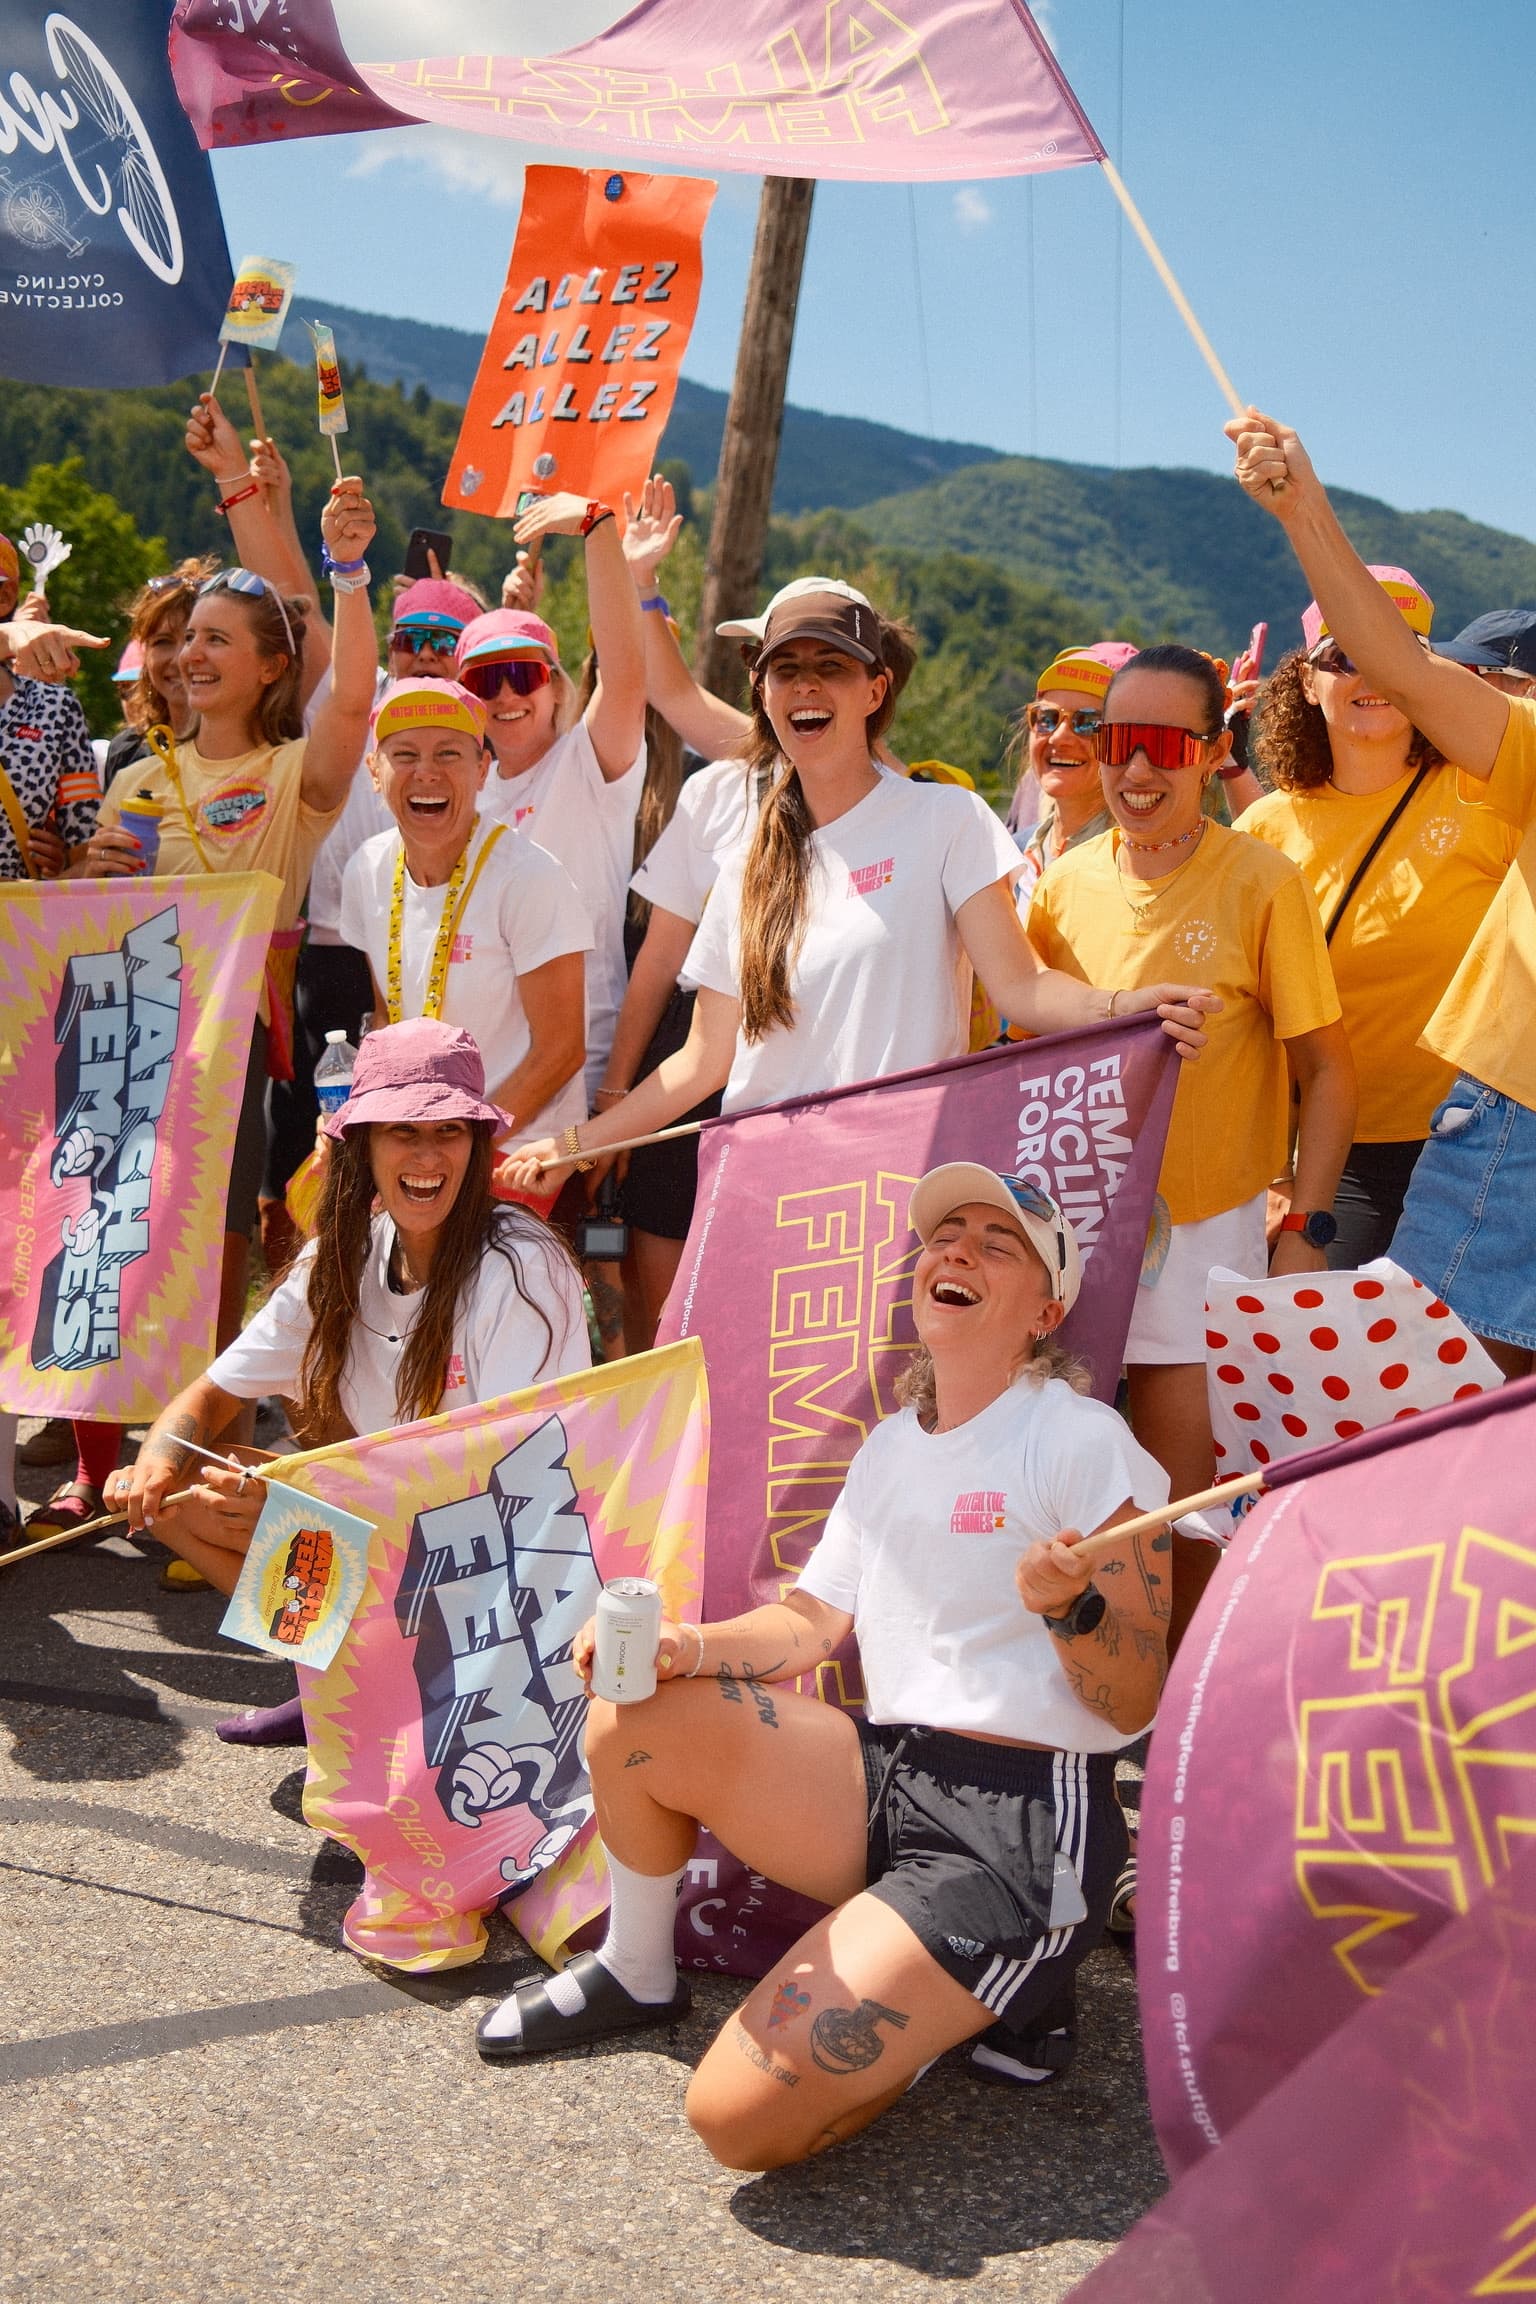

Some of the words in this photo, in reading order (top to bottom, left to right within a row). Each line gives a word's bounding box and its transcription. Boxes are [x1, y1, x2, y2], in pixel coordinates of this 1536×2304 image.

[513, 262, 679, 313] ALLEZ
[503, 321, 671, 370] ALLEZ
[492, 381, 658, 428] ALLEZ
[111, 903, 184, 1255] WATCH
[20, 1108, 46, 1145] THE
[1015, 1075, 1052, 1196] FORC
[17, 1151, 42, 1218] CHEER
[13, 1223, 37, 1299] SQUAD
[91, 1260, 122, 1360] THE
[951, 1513, 993, 1533] FEMMES
[953, 1491, 985, 1512] WATCH
[986, 1491, 1008, 1512] THE
[301, 1530, 334, 1622] WATCH
[379, 1731, 408, 1786] THE
[384, 1794, 446, 1869] CHEER
